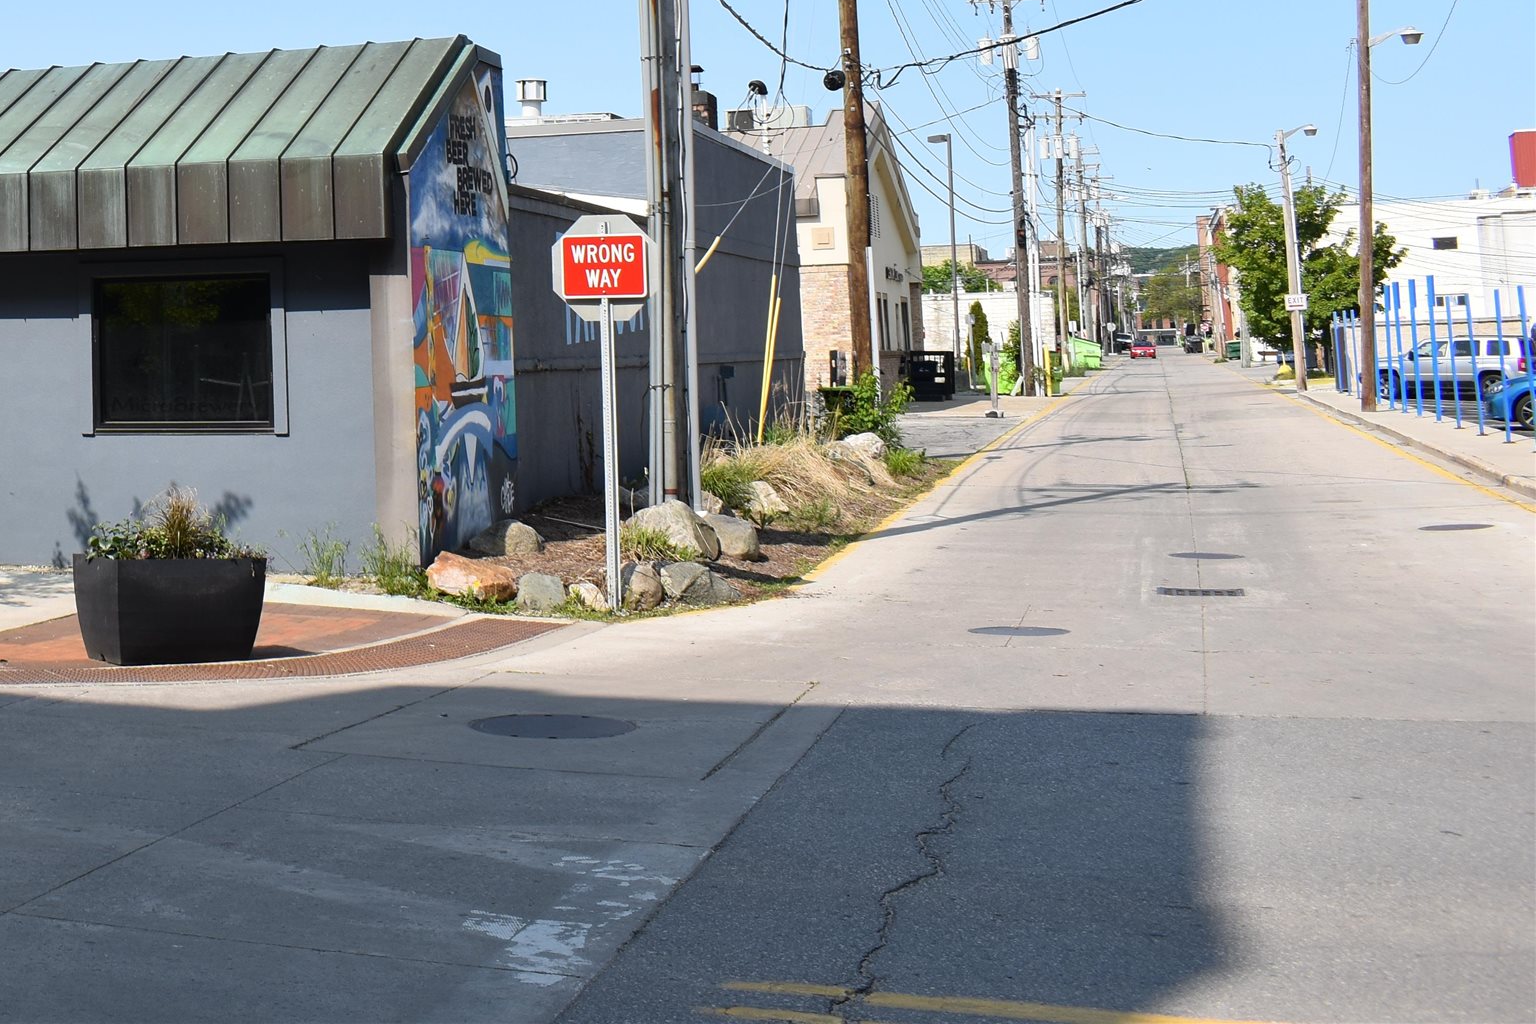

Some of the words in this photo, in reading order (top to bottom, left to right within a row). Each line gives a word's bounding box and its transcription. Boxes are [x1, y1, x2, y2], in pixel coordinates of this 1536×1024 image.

[449, 114, 476, 140] FRESH
[446, 139, 469, 167] BEER
[457, 167, 492, 195] BREWED
[454, 190, 477, 216] HERE
[571, 243, 635, 264] WRONG
[585, 268, 621, 288] WAY
